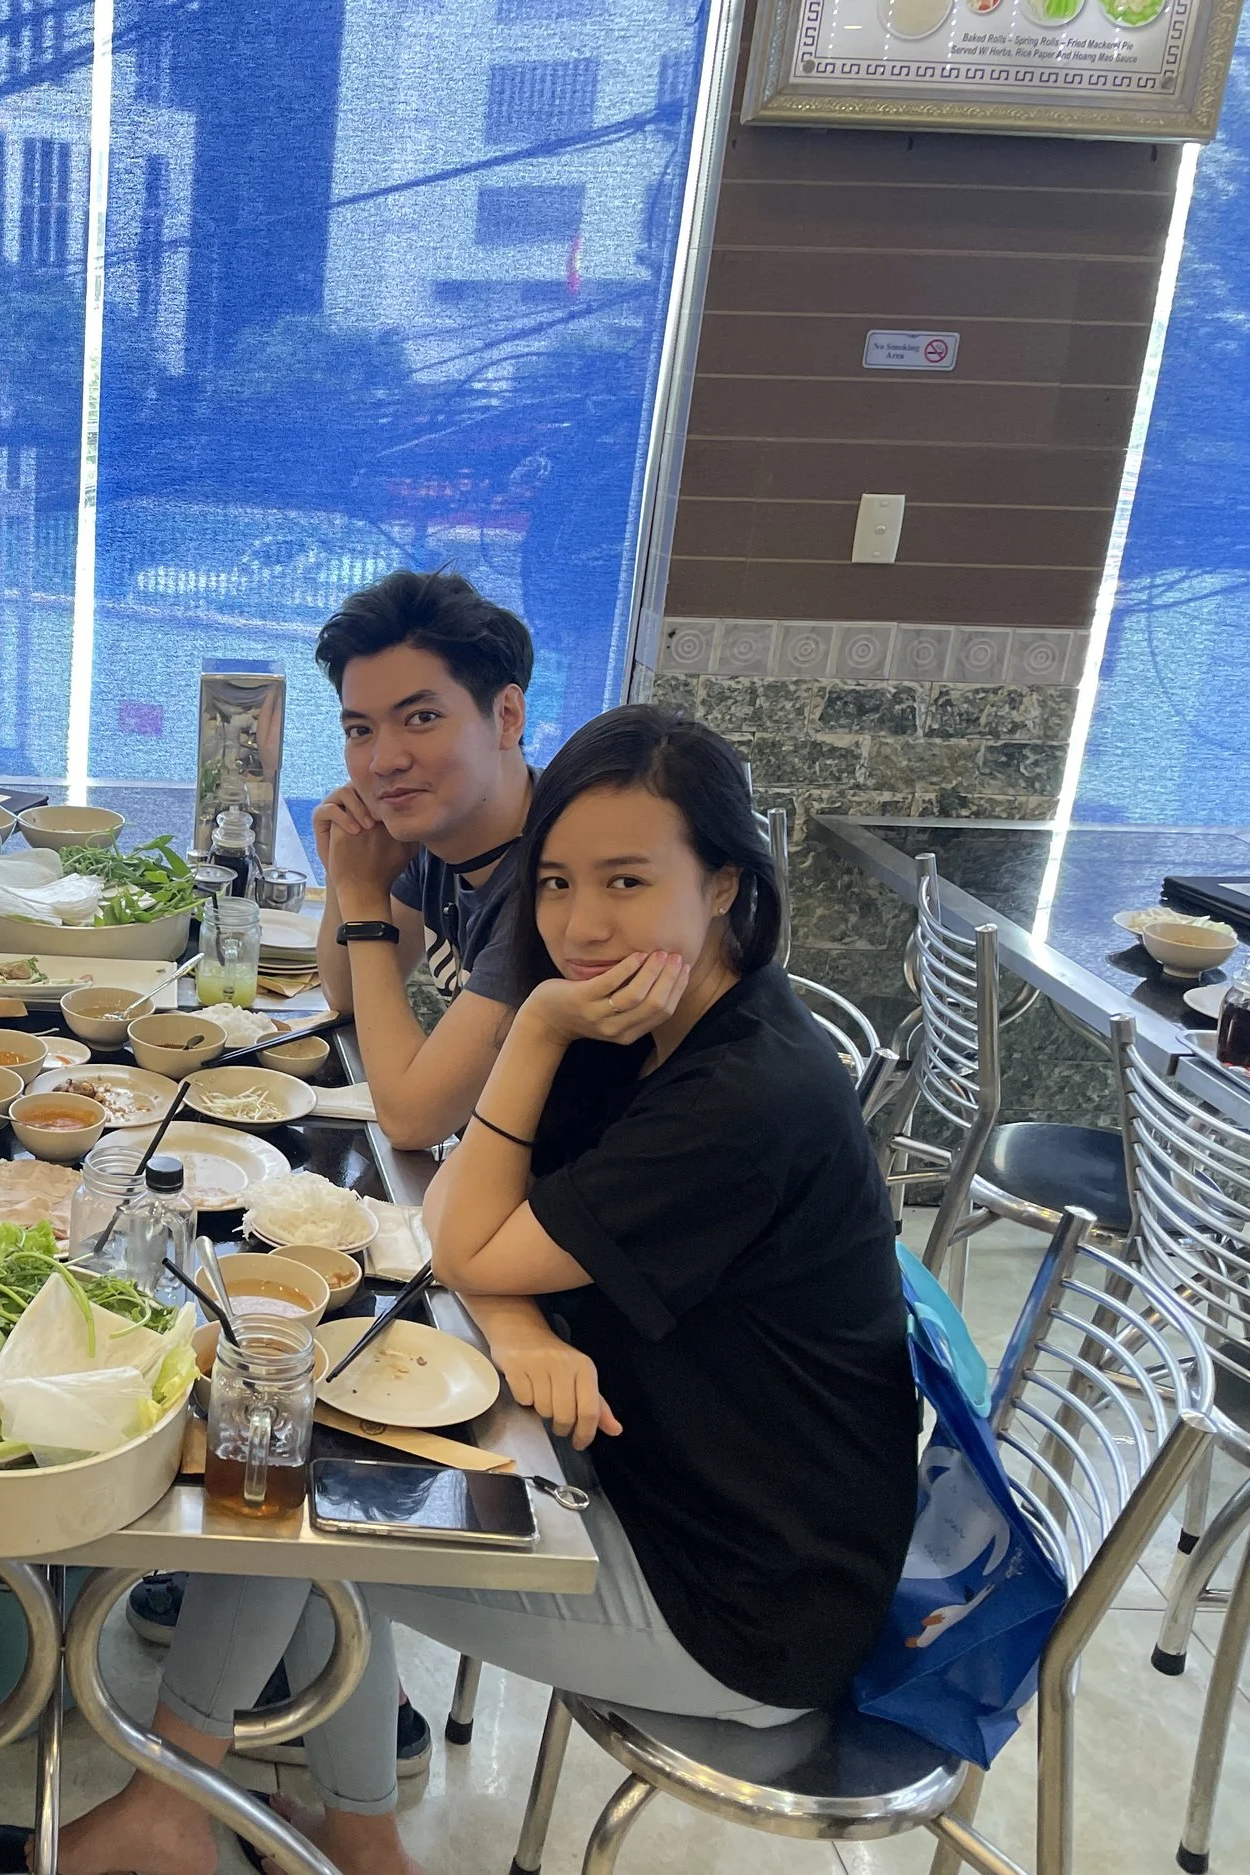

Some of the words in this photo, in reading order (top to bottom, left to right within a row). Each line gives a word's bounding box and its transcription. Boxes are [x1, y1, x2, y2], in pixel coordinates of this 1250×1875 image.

[962, 33, 987, 43] Baked
[987, 34, 1007, 44] Rolls
[1014, 35, 1039, 48] Spring
[1040, 36, 1059, 47] Rolls
[1067, 38, 1087, 48] Fried
[1121, 41, 1134, 51] Pie
[951, 45, 978, 55] Served
[1015, 48, 1032, 58] Rice
[1033, 49, 1054, 60] Paper
[1055, 50, 1072, 60] And
[1115, 53, 1138, 64] Sauce
[885, 343, 920, 353] Smoking
[886, 352, 904, 360] Area
